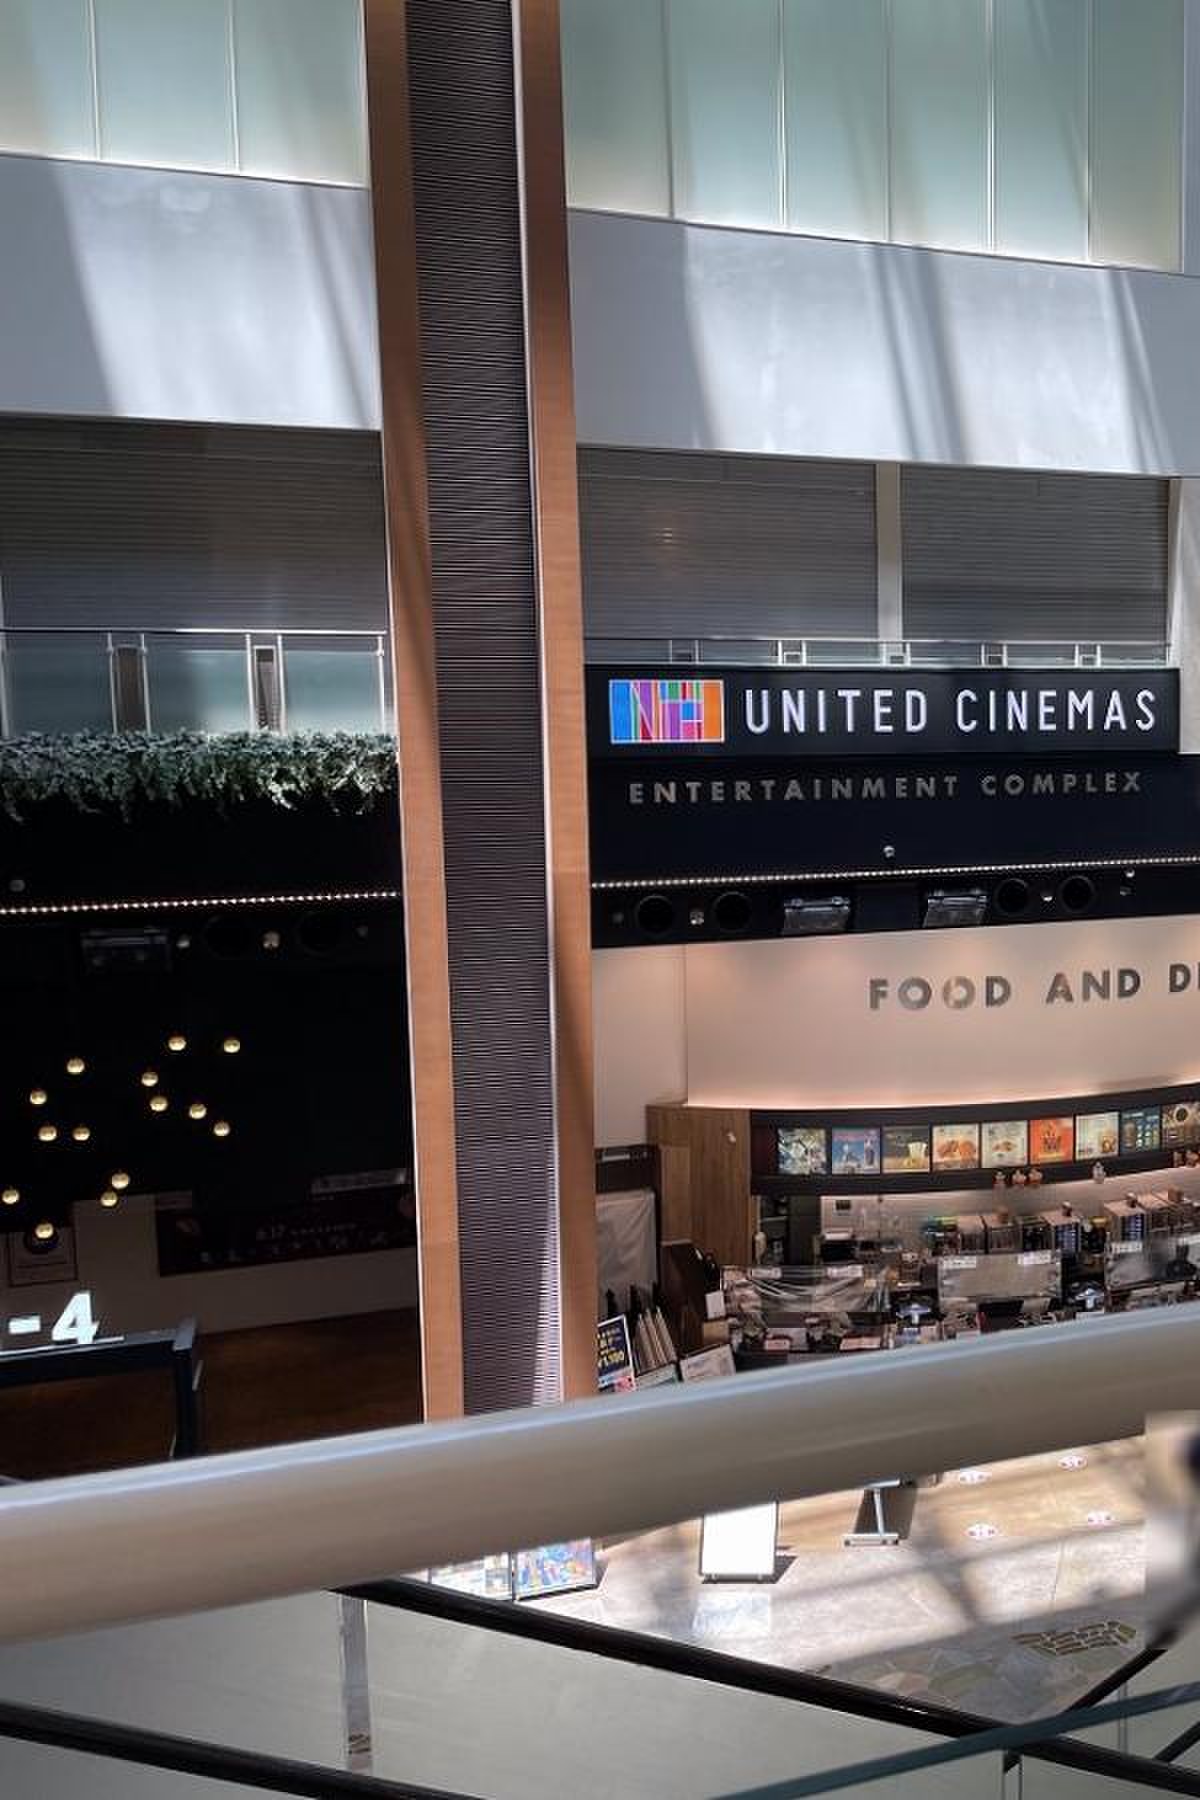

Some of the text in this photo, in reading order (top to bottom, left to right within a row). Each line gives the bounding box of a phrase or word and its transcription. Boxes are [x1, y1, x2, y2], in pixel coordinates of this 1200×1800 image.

[744, 689, 1157, 735] UNITED CINEMAS
[629, 771, 1142, 805] ENTERTAINMENT COMPLEX
[868, 975, 1013, 1011] FOOD
[1045, 967, 1142, 1005] AND
